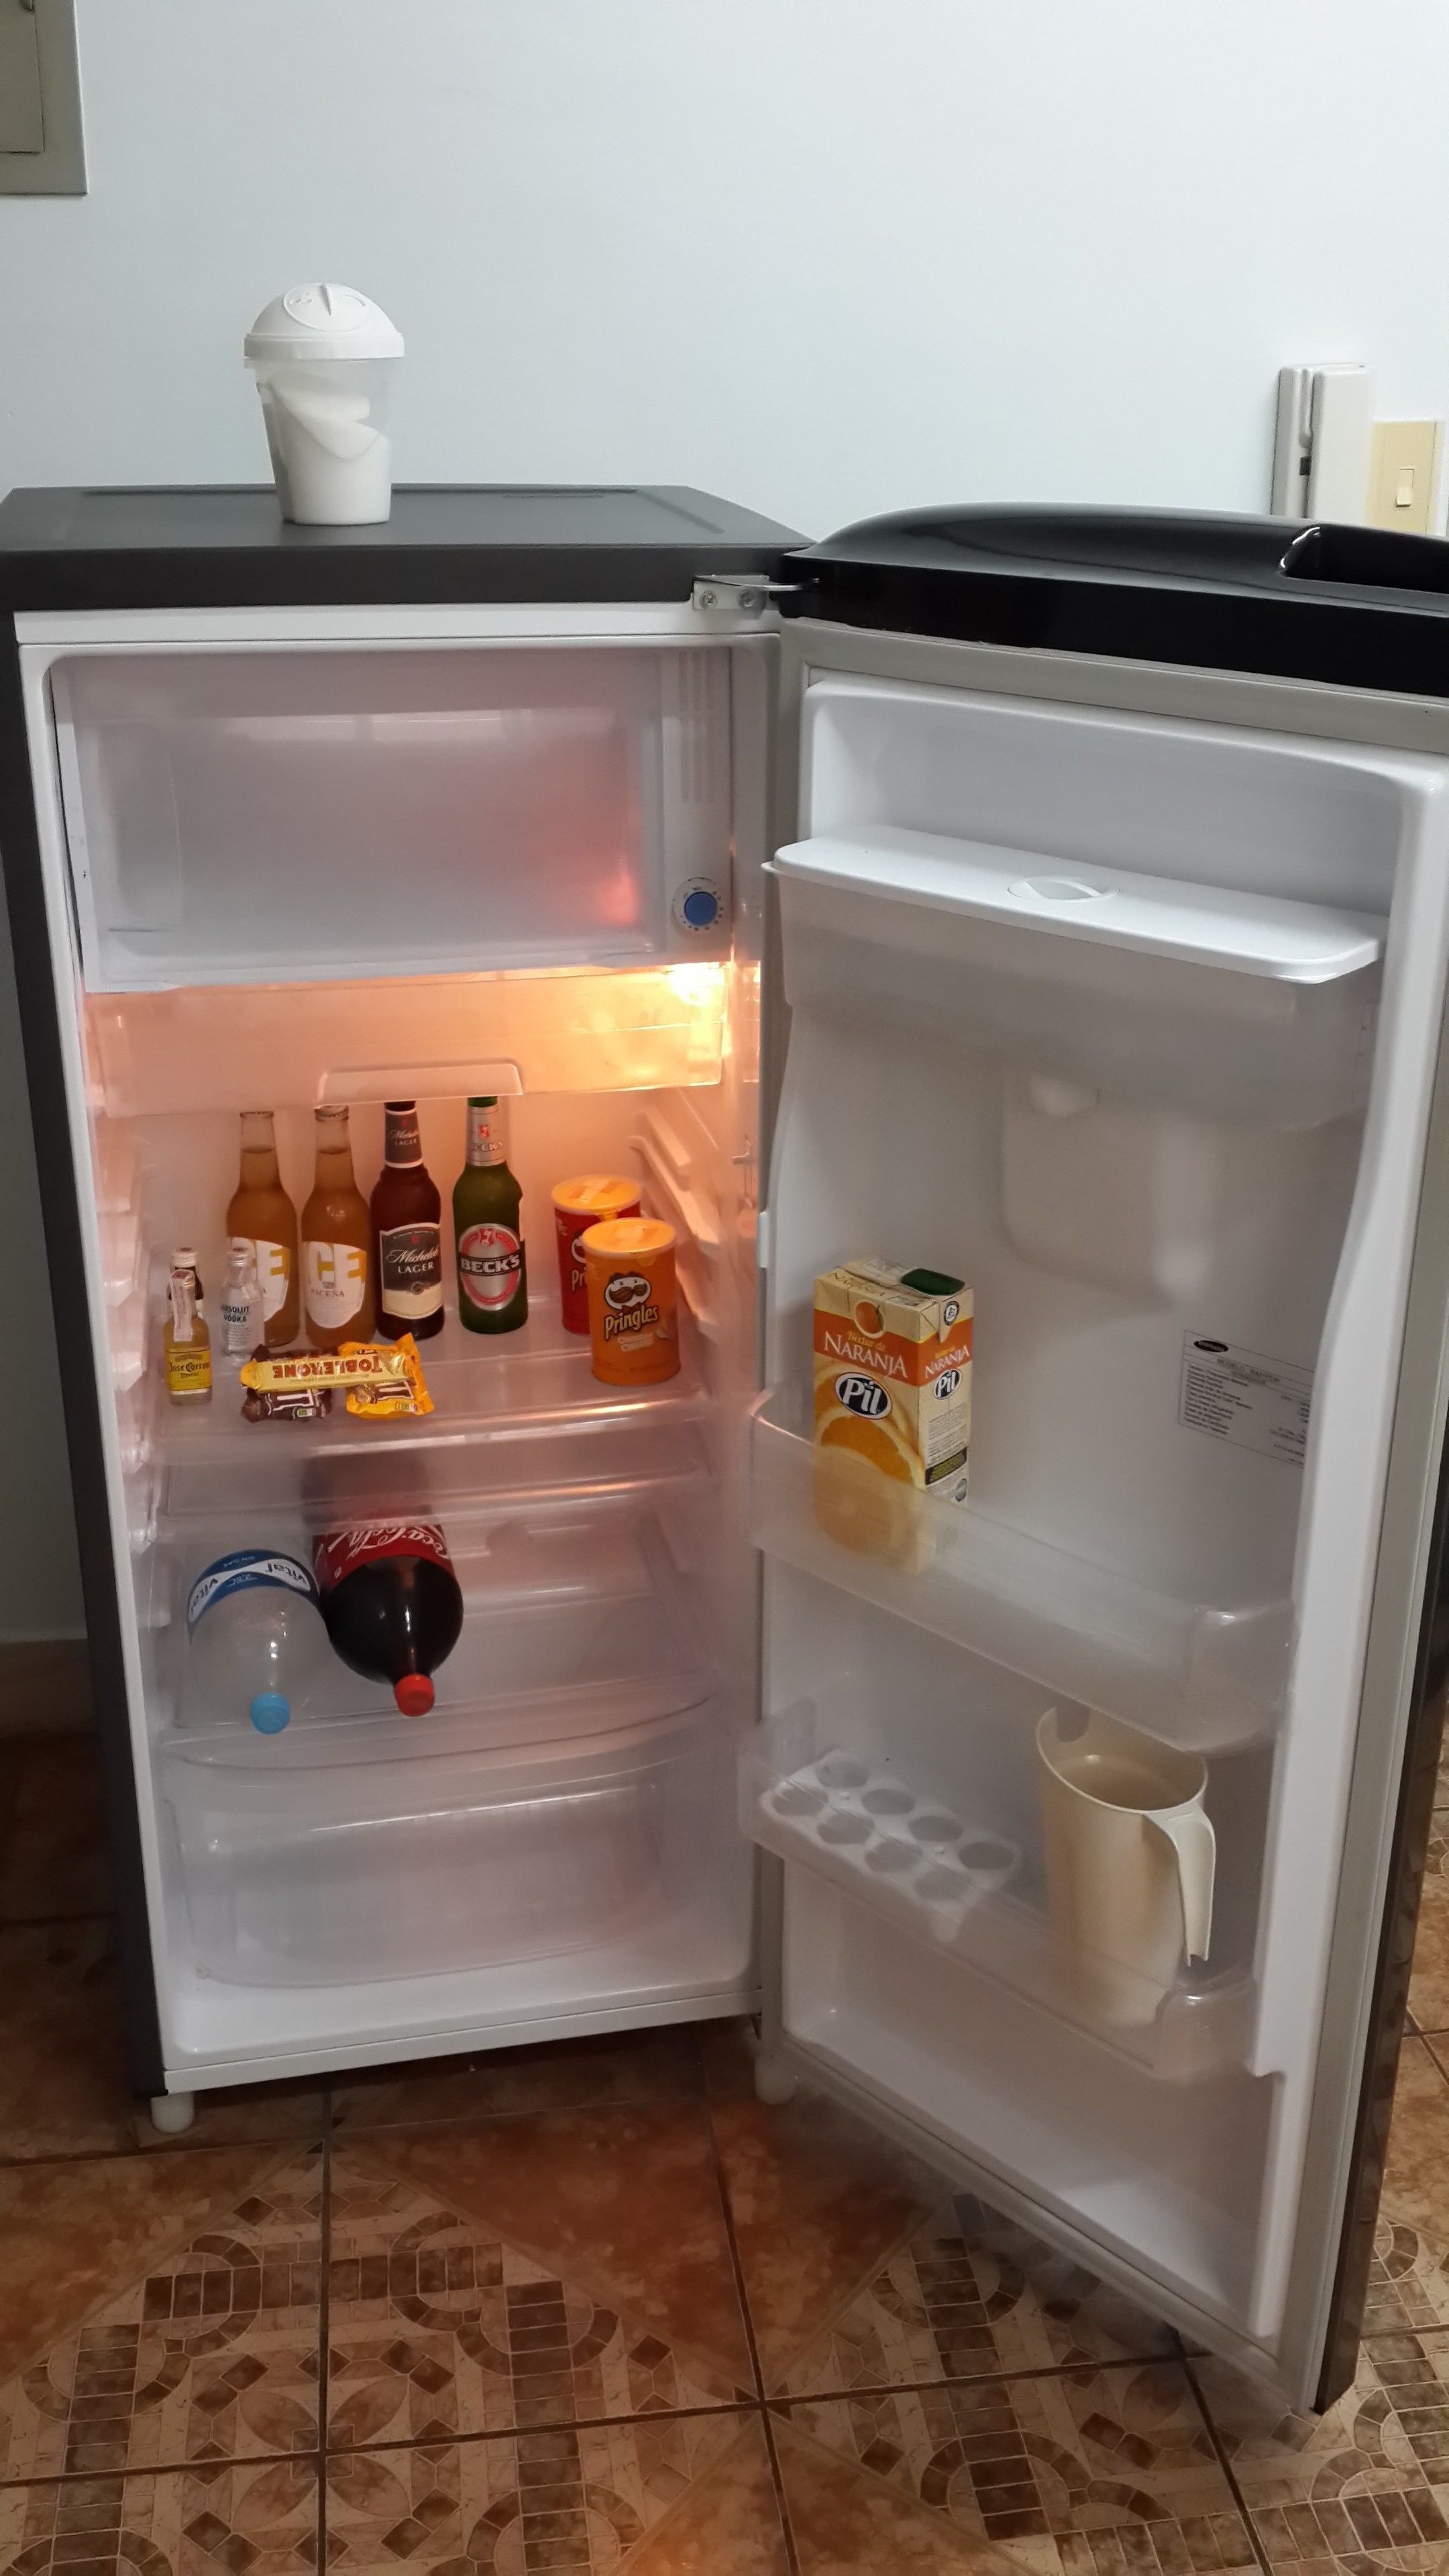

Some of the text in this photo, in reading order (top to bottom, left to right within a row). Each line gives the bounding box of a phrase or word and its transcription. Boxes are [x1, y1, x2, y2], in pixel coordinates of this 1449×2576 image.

[397, 1260, 435, 1274] LAGER
[460, 1253, 521, 1273] BECK'S
[604, 1305, 658, 1340] Pringles
[272, 1355, 382, 1379] TOBLERONE
[824, 1331, 908, 1379] NARANJA
[924, 1344, 970, 1379] NARANJA
[843, 1378, 883, 1415] Pil
[937, 1369, 958, 1397] Pil
